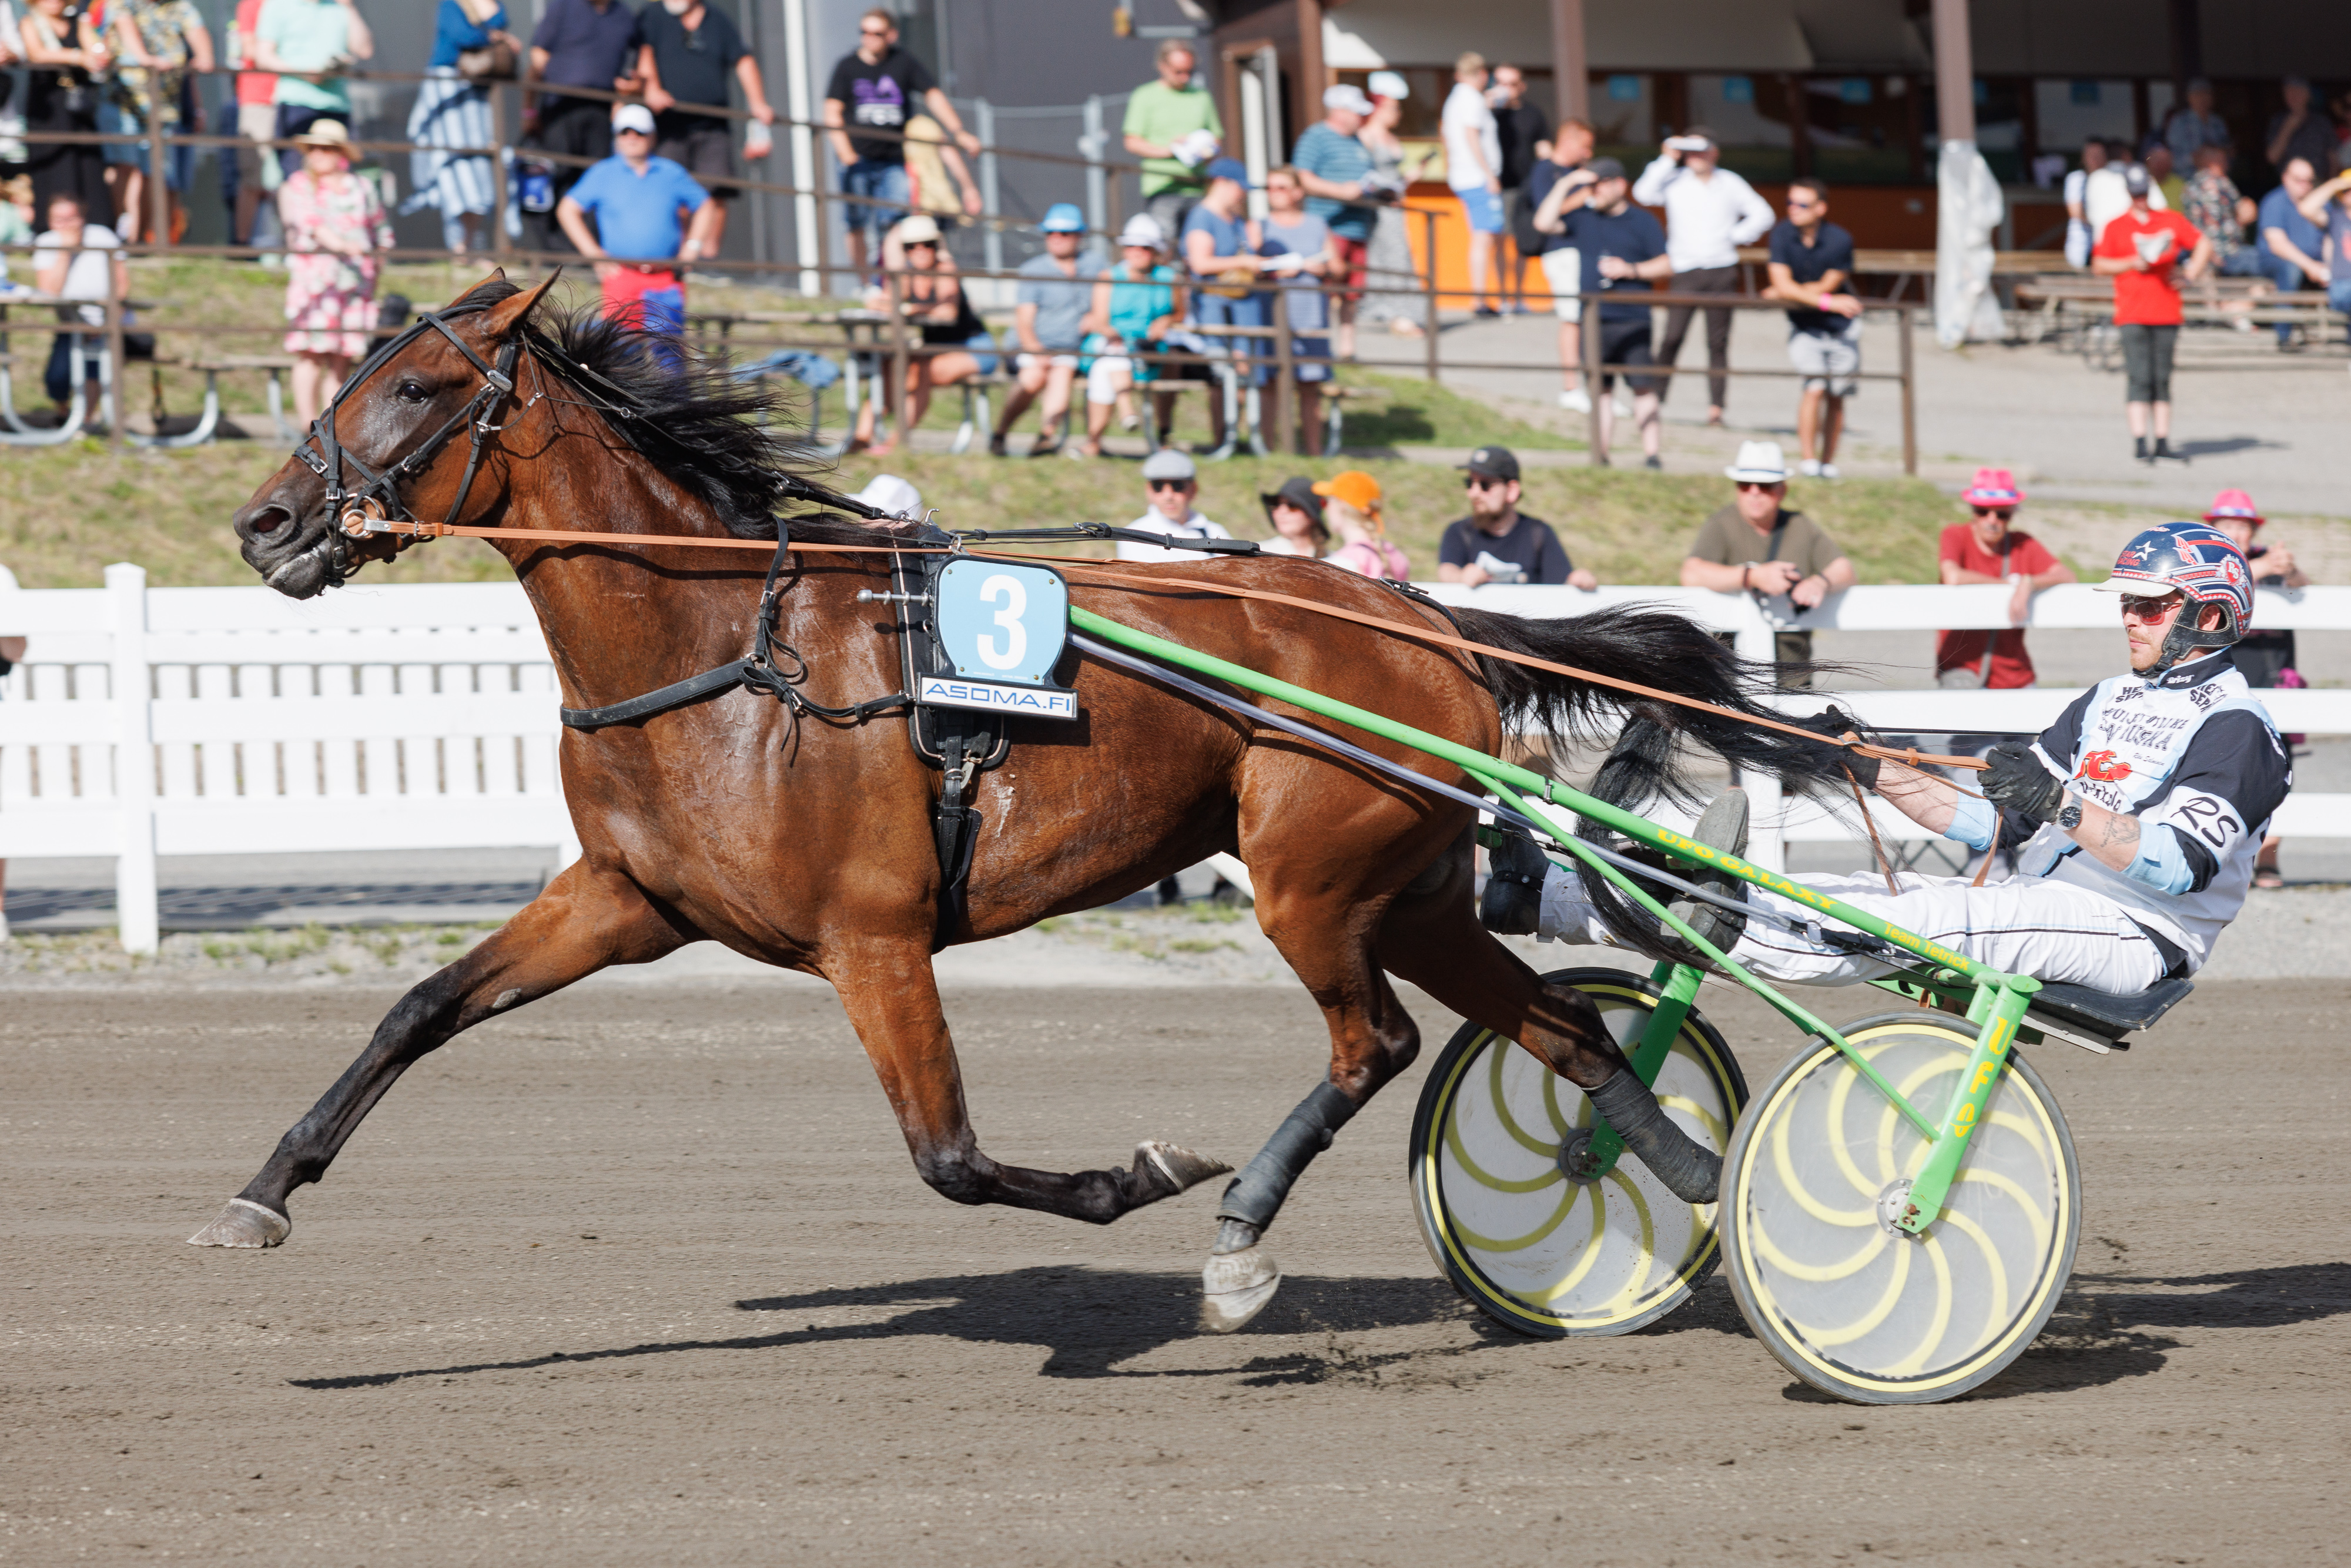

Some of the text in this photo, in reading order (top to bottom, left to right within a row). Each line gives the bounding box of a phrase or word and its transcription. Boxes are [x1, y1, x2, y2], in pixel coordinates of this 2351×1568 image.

[976, 574, 1027, 670] 3
[925, 683, 1070, 712] ASOMA.FI
[2171, 796, 2238, 849] RS
[1657, 829, 1838, 910] UFO GALAXY
[1883, 921, 1970, 972] Team Tetrick
[1950, 1016, 2015, 1138] UFO
